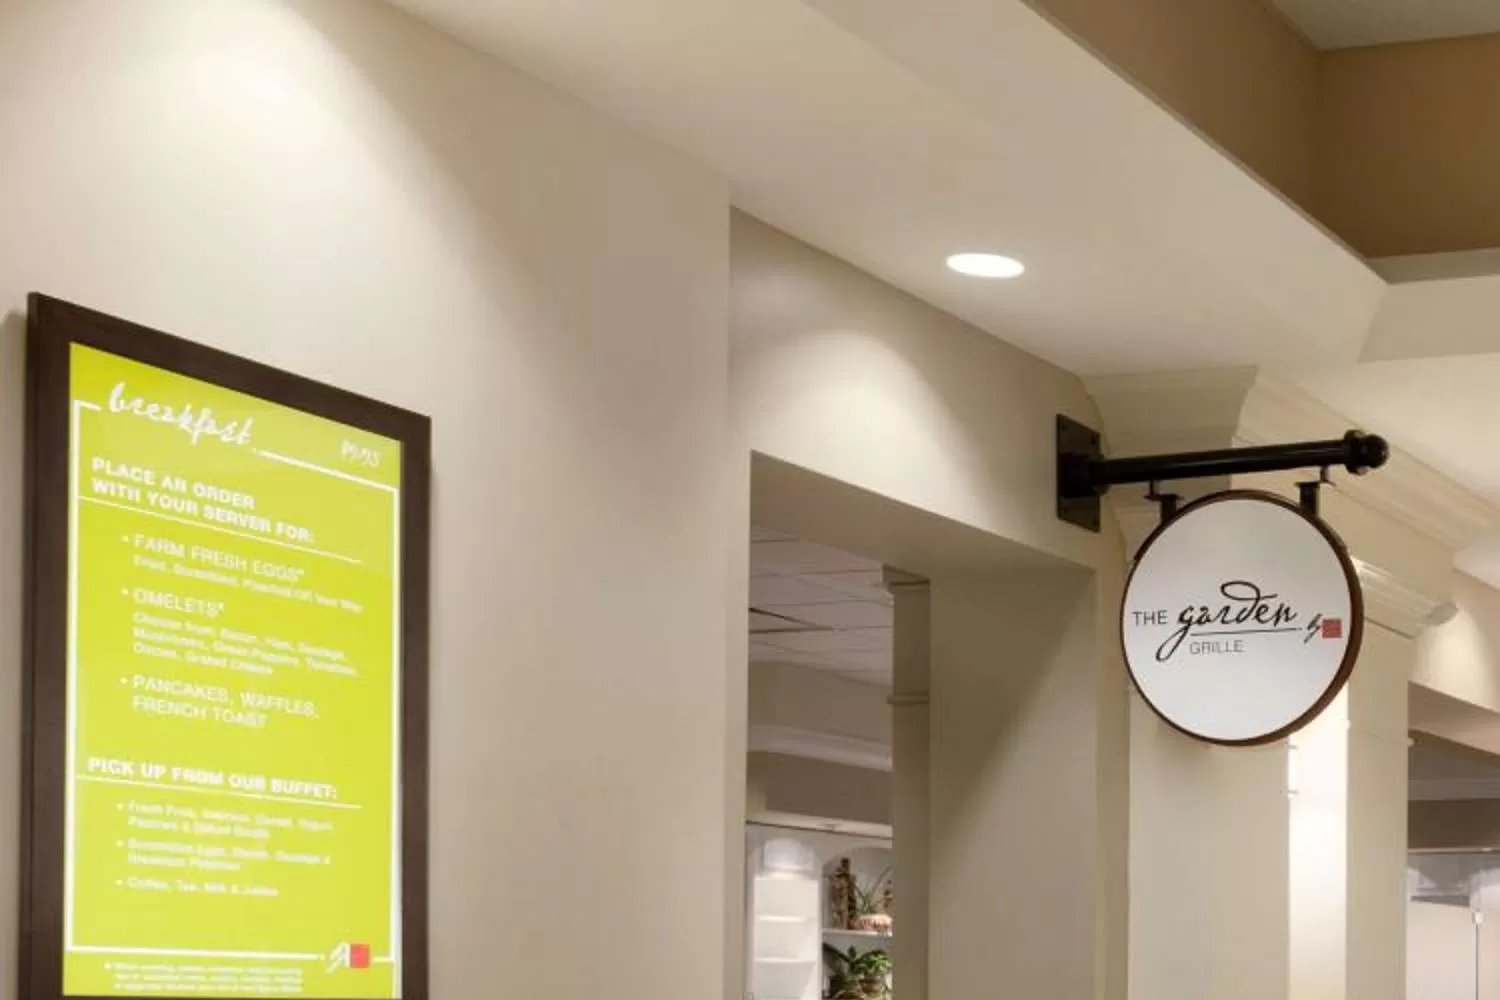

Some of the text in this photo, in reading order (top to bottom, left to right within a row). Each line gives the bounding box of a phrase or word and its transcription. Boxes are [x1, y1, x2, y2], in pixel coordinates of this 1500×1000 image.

[108, 382, 254, 446] breakfast
[91, 456, 256, 510] PLACE AN ORDER
[91, 478, 315, 544] WITH YOUR SERVER FOR:
[134, 534, 185, 559] FARM
[191, 545, 248, 573] FRESH
[1132, 580, 1299, 663] THE garden
[1189, 640, 1245, 655] GRILLE
[133, 696, 267, 729] FRENCH TOAST
[88, 756, 337, 799] PICK UP FROM OUR BUFFET:
